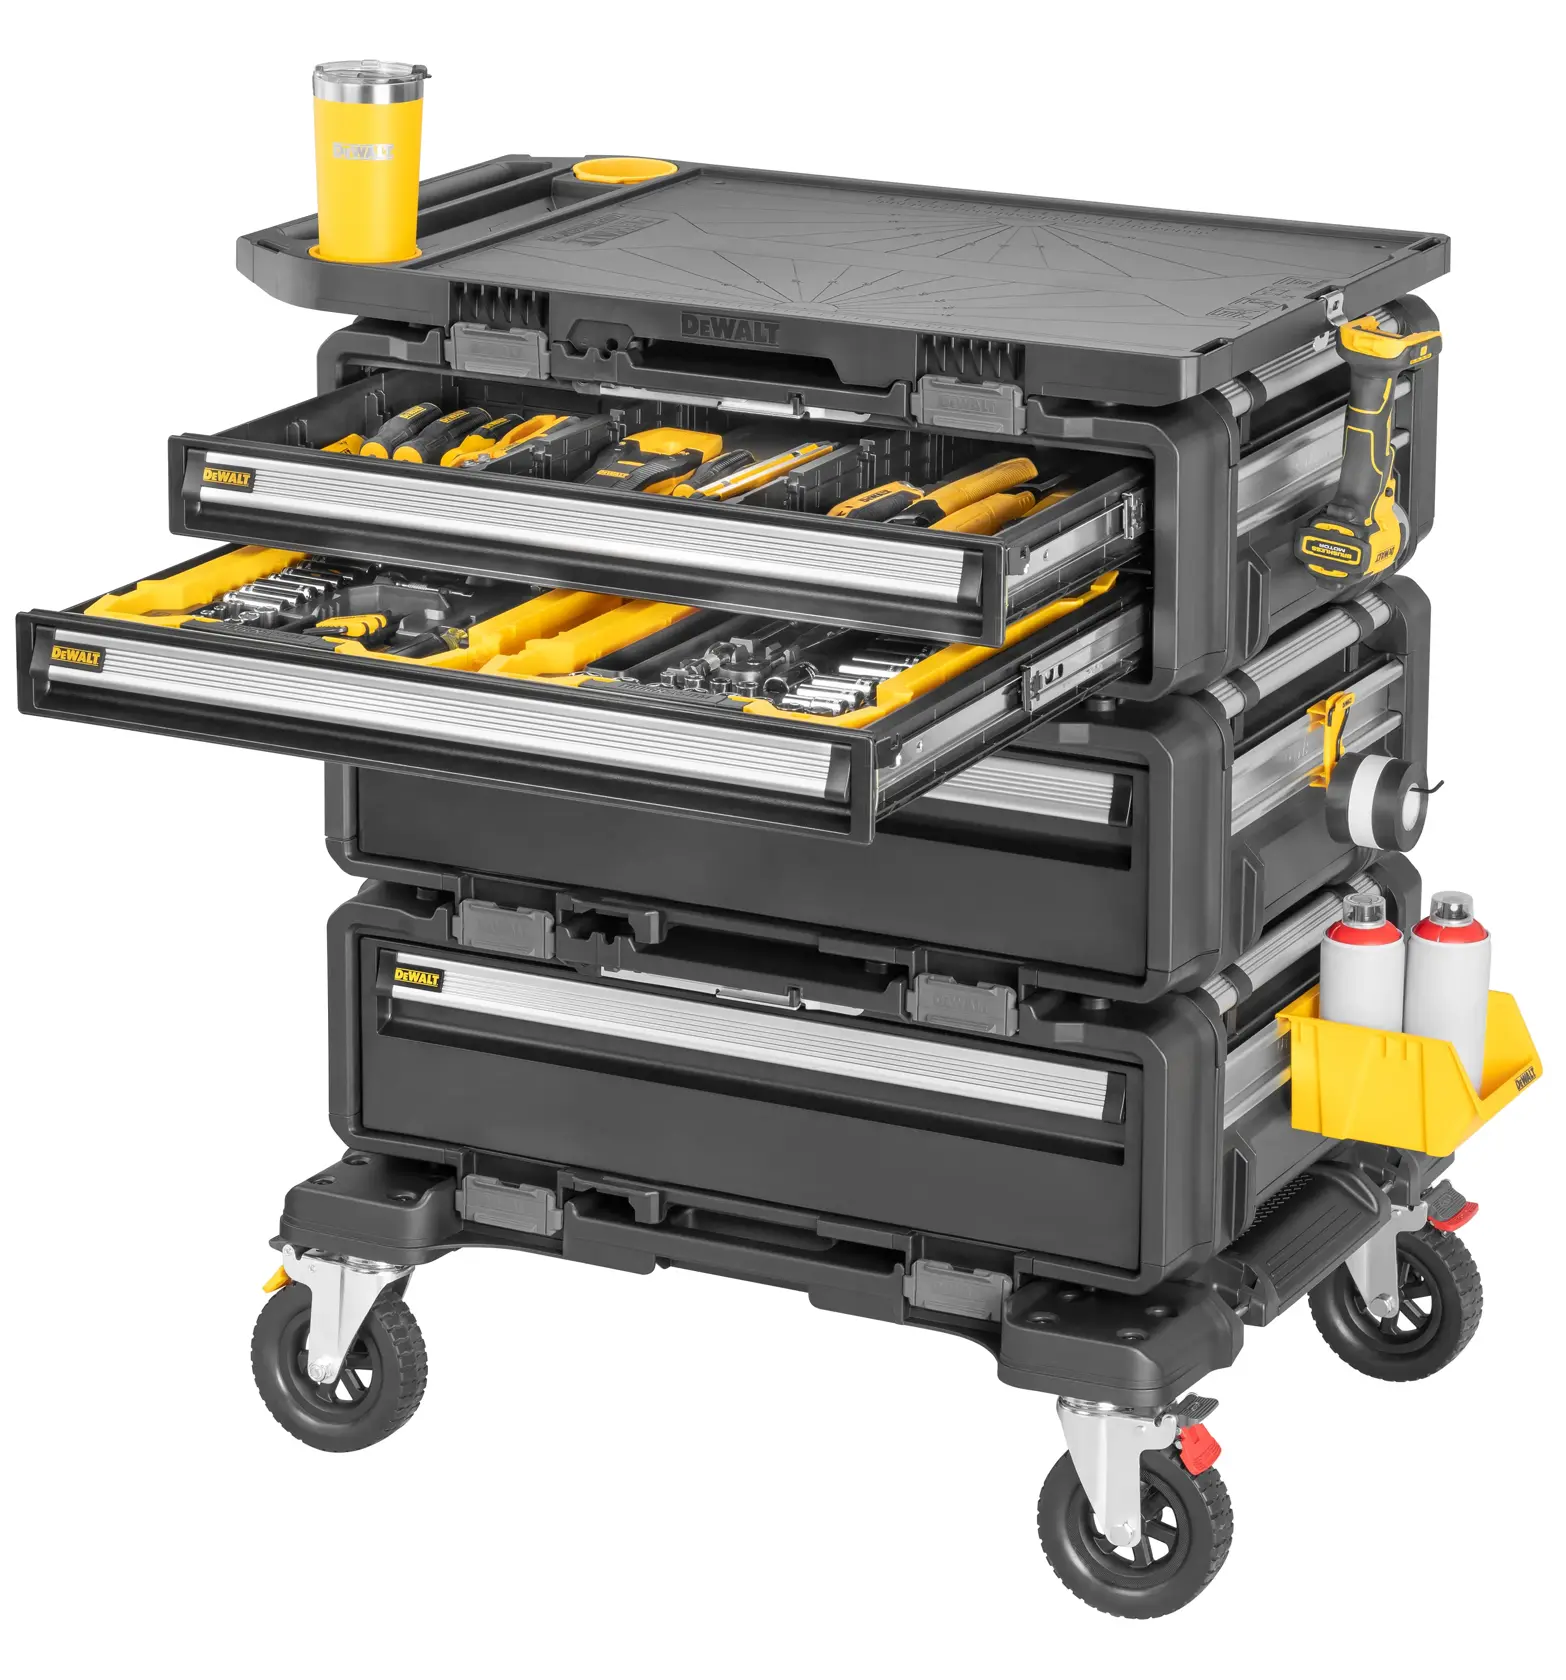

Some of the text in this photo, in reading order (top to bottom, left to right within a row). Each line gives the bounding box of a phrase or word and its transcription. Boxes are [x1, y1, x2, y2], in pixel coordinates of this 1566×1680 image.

[681, 312, 780, 346] DEWALT
[203, 466, 251, 487] DEWALT
[51, 645, 101, 666] DEWALT
[394, 967, 440, 988] DEWALT
